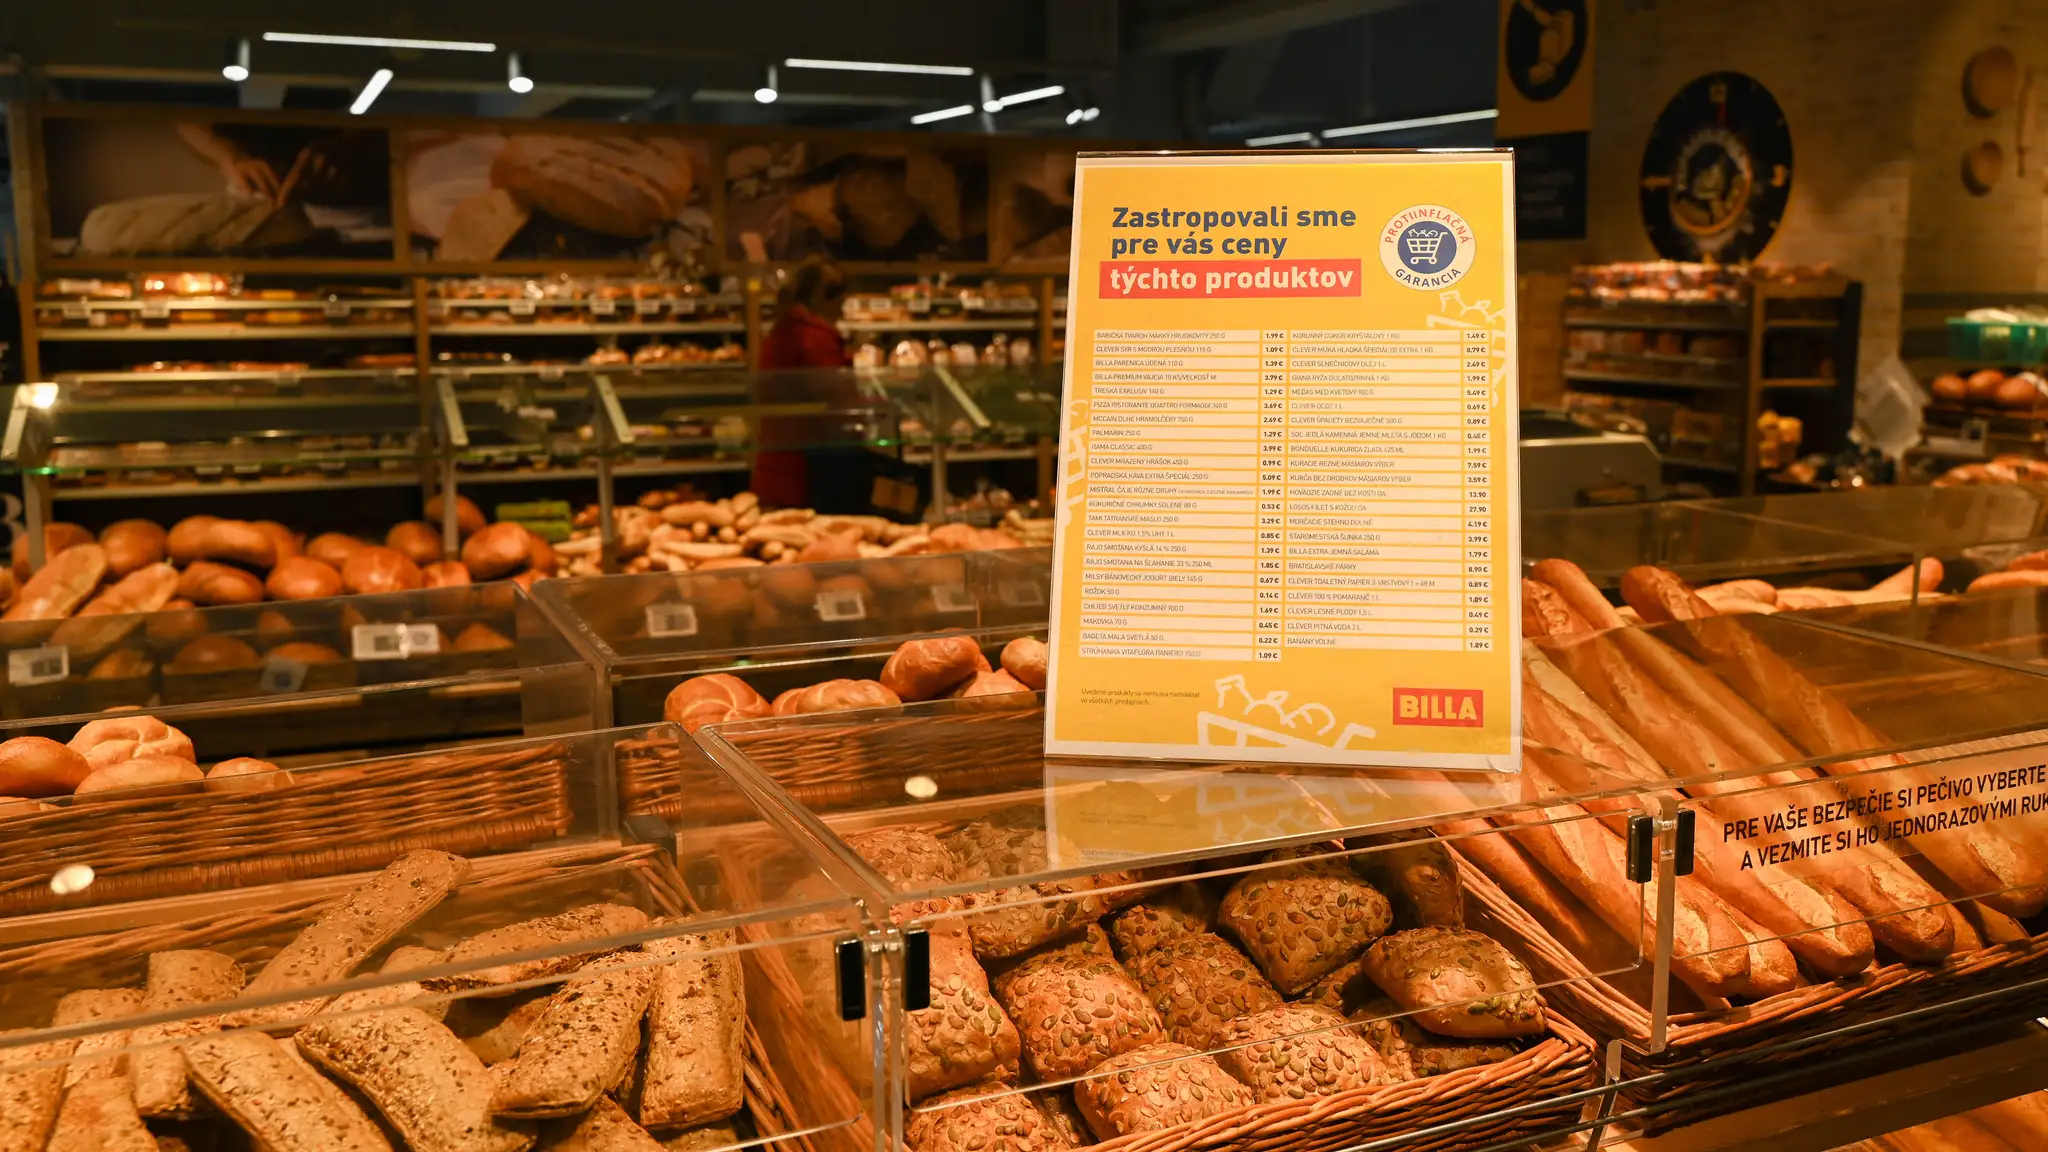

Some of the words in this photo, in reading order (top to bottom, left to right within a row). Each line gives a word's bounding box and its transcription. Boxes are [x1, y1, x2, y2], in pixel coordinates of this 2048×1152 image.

[1112, 206, 1288, 232] Zastropovali
[1296, 211, 1356, 227] sme
[1384, 208, 1472, 244] PROTIINFLAČNÁ
[1112, 238, 1158, 260] pre
[1167, 232, 1214, 254] vás
[1222, 237, 1288, 258] ceny
[1110, 266, 1197, 294] týchto
[1206, 269, 1354, 293] produktov
[1396, 268, 1462, 288] GARANCIA
[1084, 587, 1106, 595] ROŽOK
[1399, 694, 1478, 720] BILLA
[1724, 818, 1759, 843] PRE
[1764, 805, 1808, 834] VAŠE
[1813, 790, 1892, 824] BEZPEČIE
[1898, 790, 1912, 808] SI
[1916, 776, 1972, 804] PEČIVO
[1976, 764, 2046, 794] VYBERTE
[1740, 850, 1753, 870] A
[1758, 834, 1832, 868] VEZMITE
[1836, 831, 1852, 850] SI
[1857, 824, 1879, 847] HO
[1884, 796, 2016, 842] JEDNORAZOVÝMI
[2021, 793, 2048, 814] RUK
